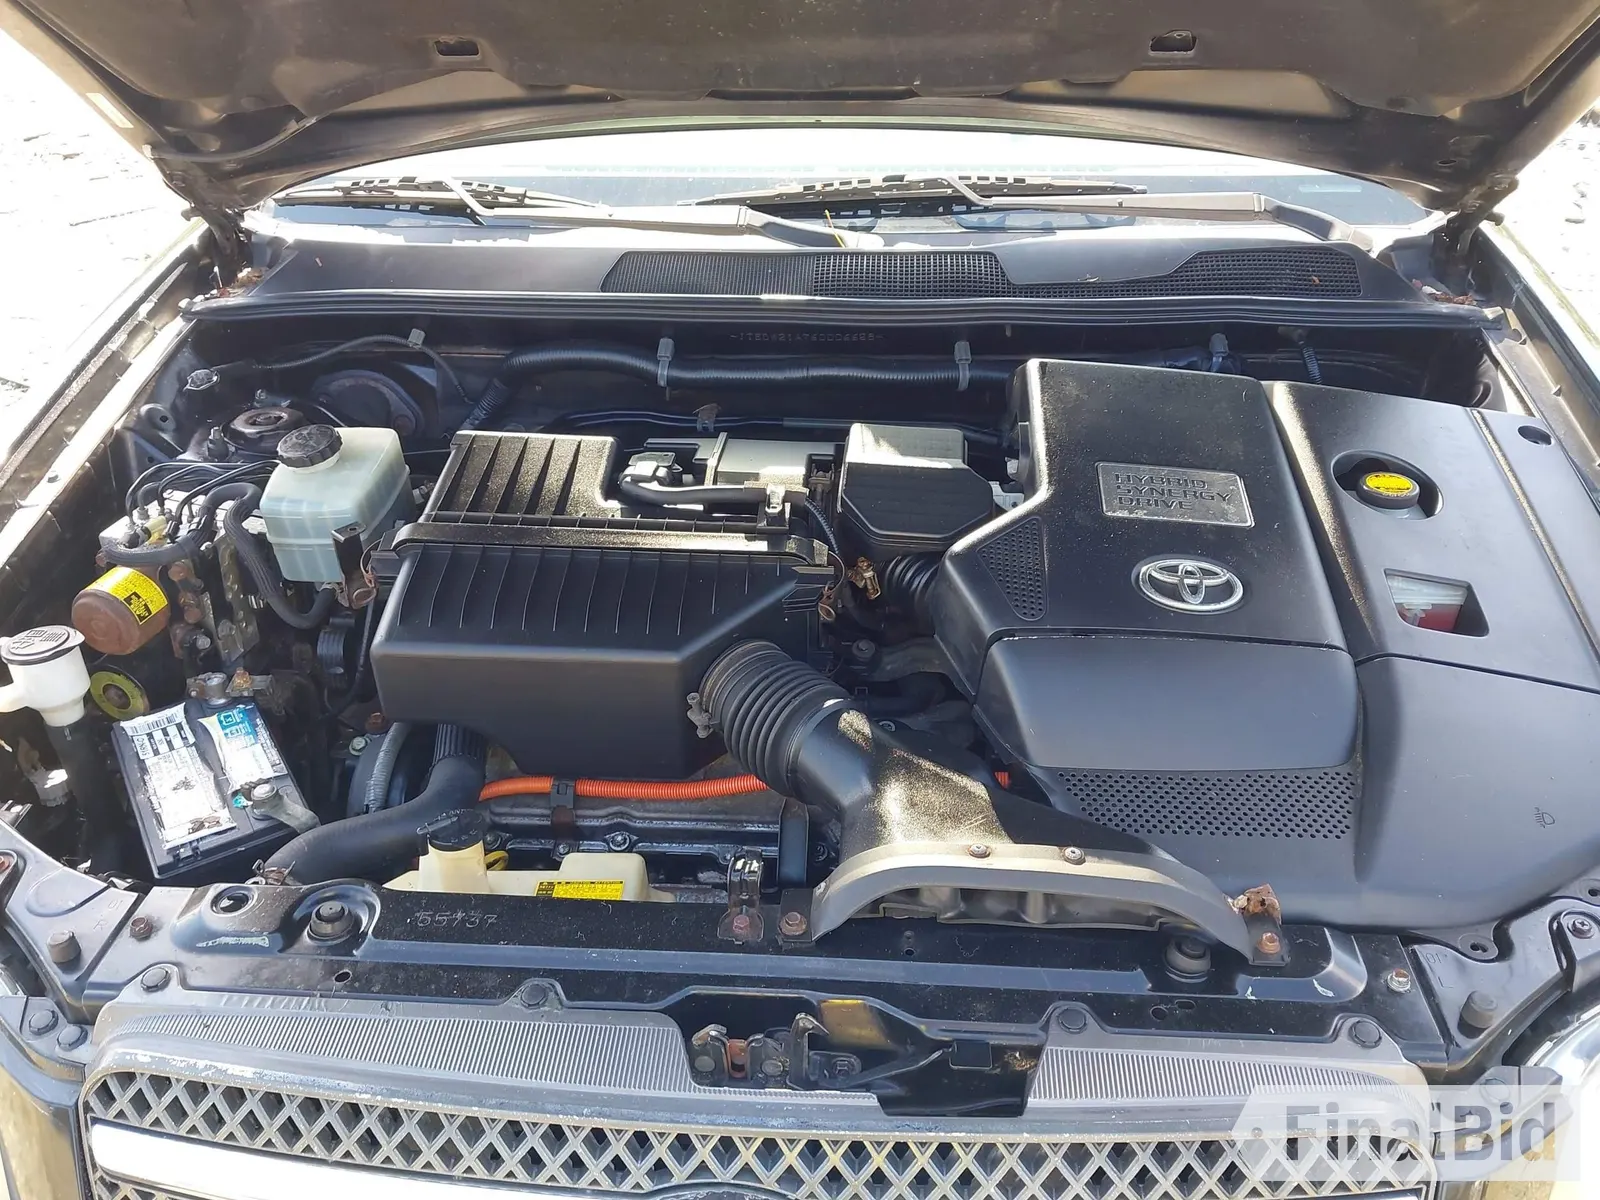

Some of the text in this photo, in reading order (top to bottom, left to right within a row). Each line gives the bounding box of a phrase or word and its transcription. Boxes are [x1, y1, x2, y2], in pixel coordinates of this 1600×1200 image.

[1115, 473, 1208, 489] HYBRID
[1116, 484, 1232, 502] SYNERGY
[1118, 496, 1193, 510] DRIVE
